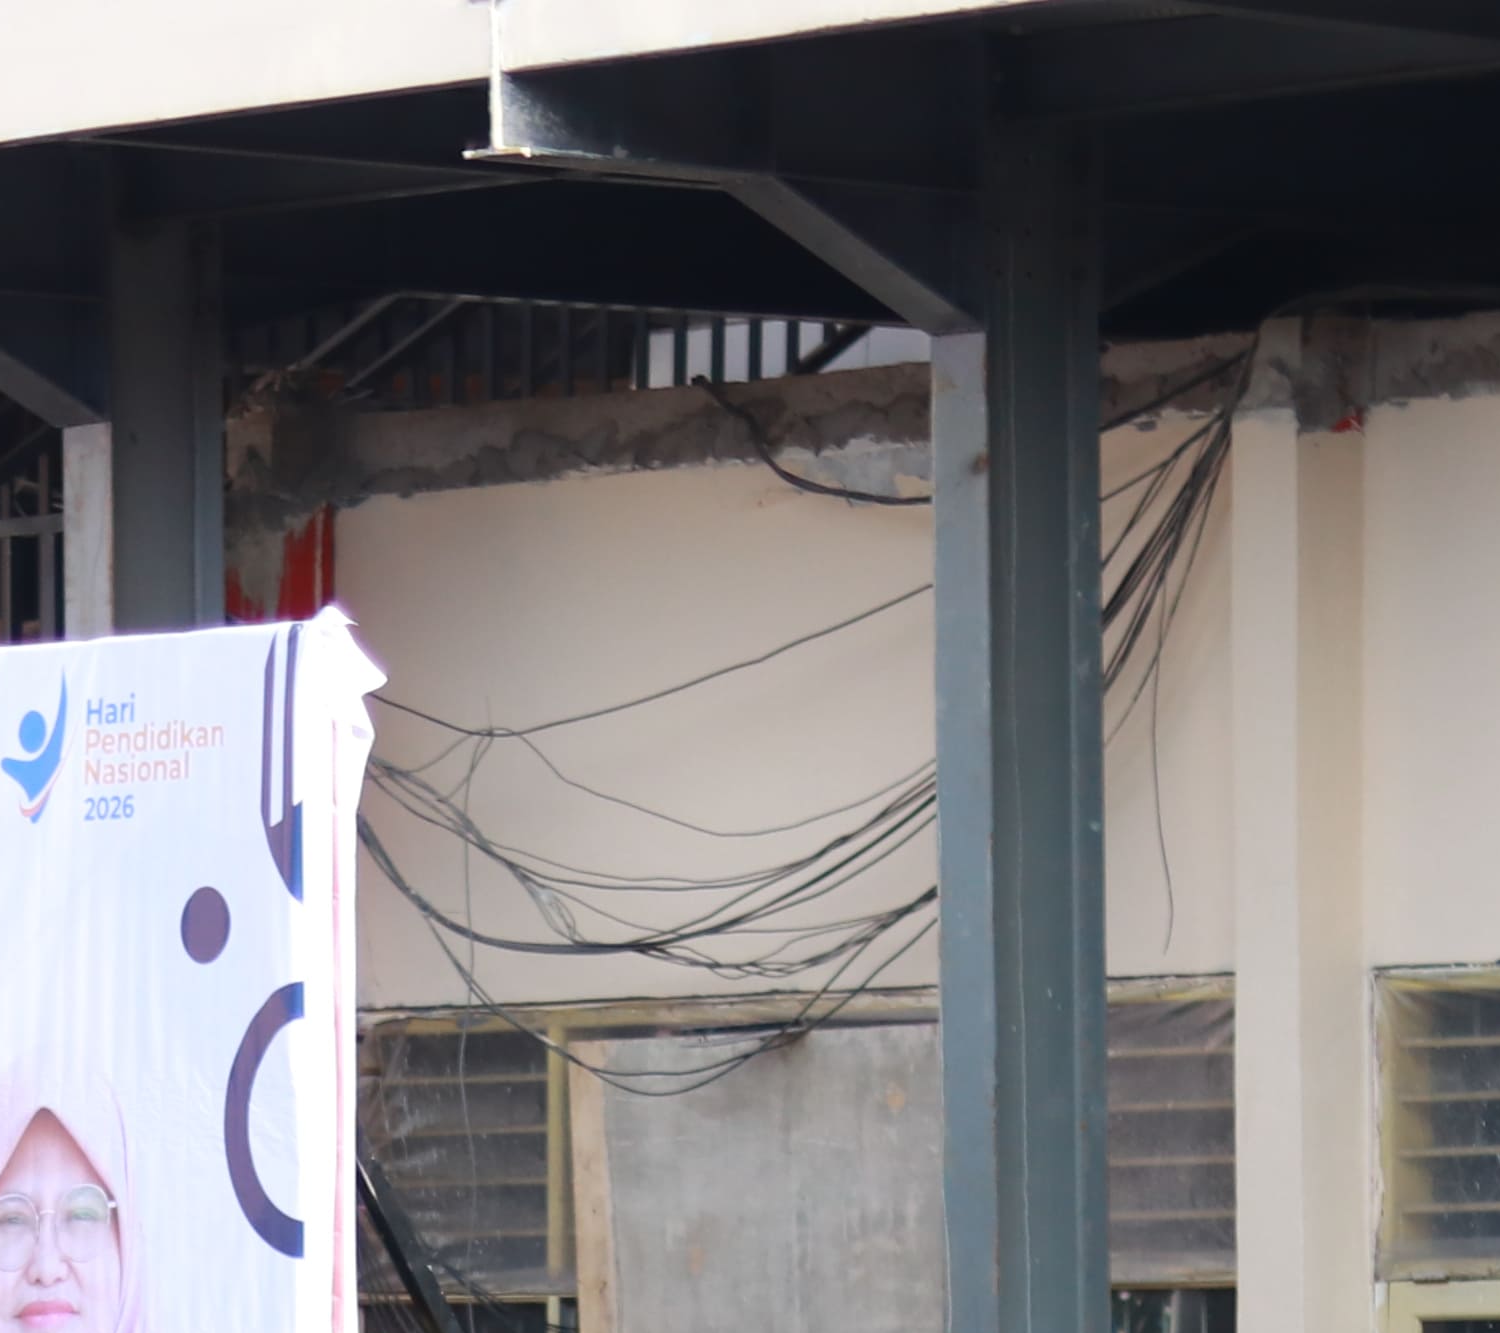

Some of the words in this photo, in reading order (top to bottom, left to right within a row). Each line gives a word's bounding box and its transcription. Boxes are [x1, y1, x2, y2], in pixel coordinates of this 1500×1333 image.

[86, 692, 136, 726] Hari
[85, 719, 224, 756] Pendidikan
[84, 751, 190, 785] Nasional
[84, 794, 135, 821] 2026
